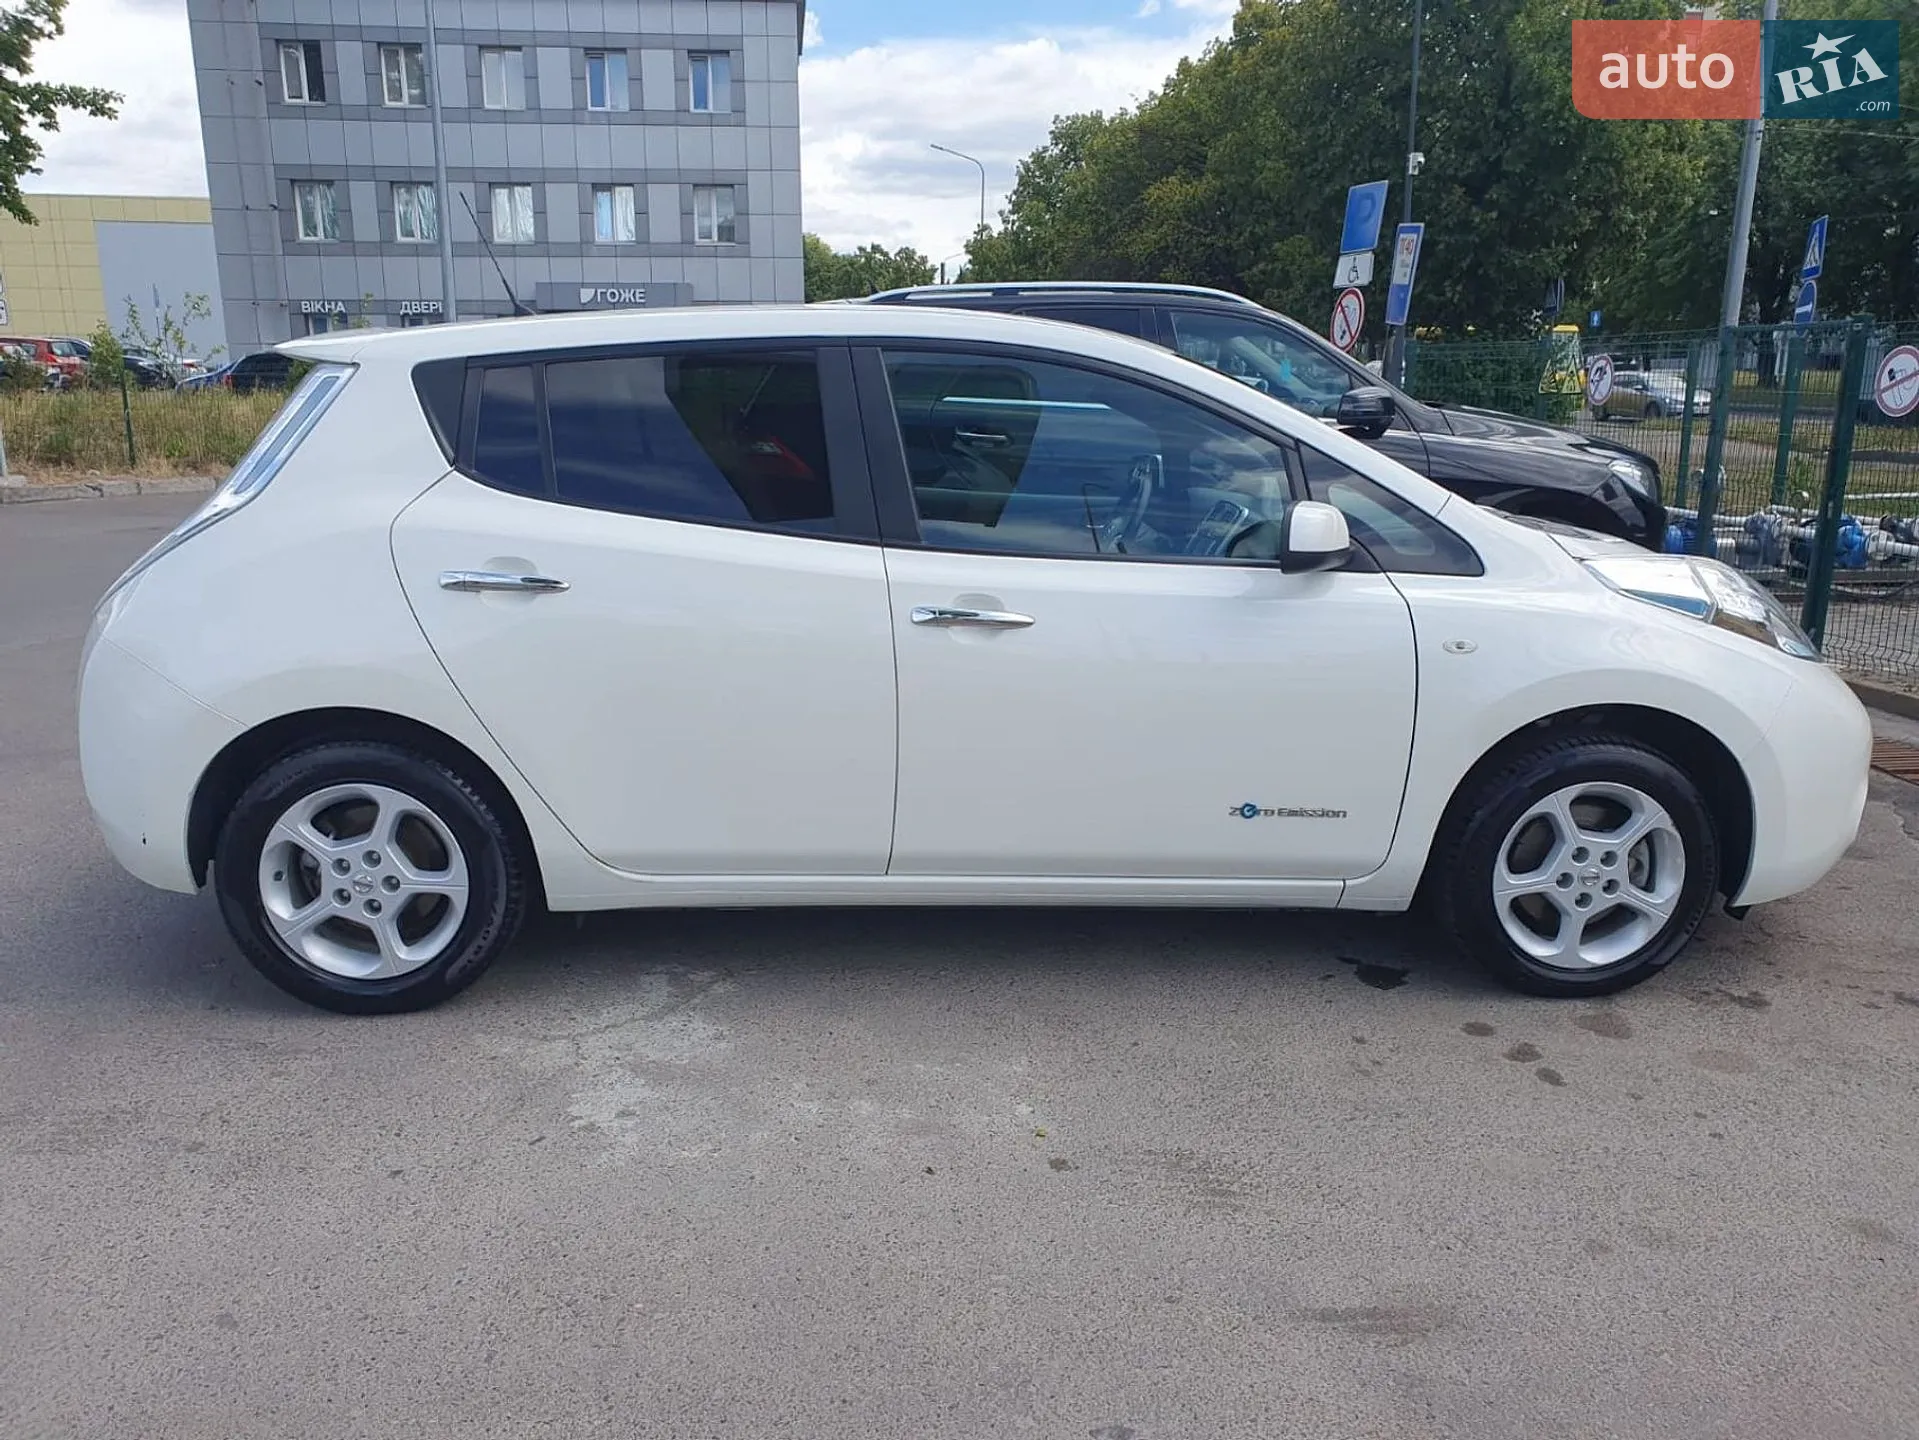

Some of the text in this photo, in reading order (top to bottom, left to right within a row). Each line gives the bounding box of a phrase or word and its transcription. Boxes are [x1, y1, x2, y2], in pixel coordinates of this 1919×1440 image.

[597, 288, 646, 303] ГОЖЕ
[301, 301, 346, 314] ВІКНА
[400, 301, 443, 315] ДВЕРІ
[1277, 807, 1348, 819] Emission
